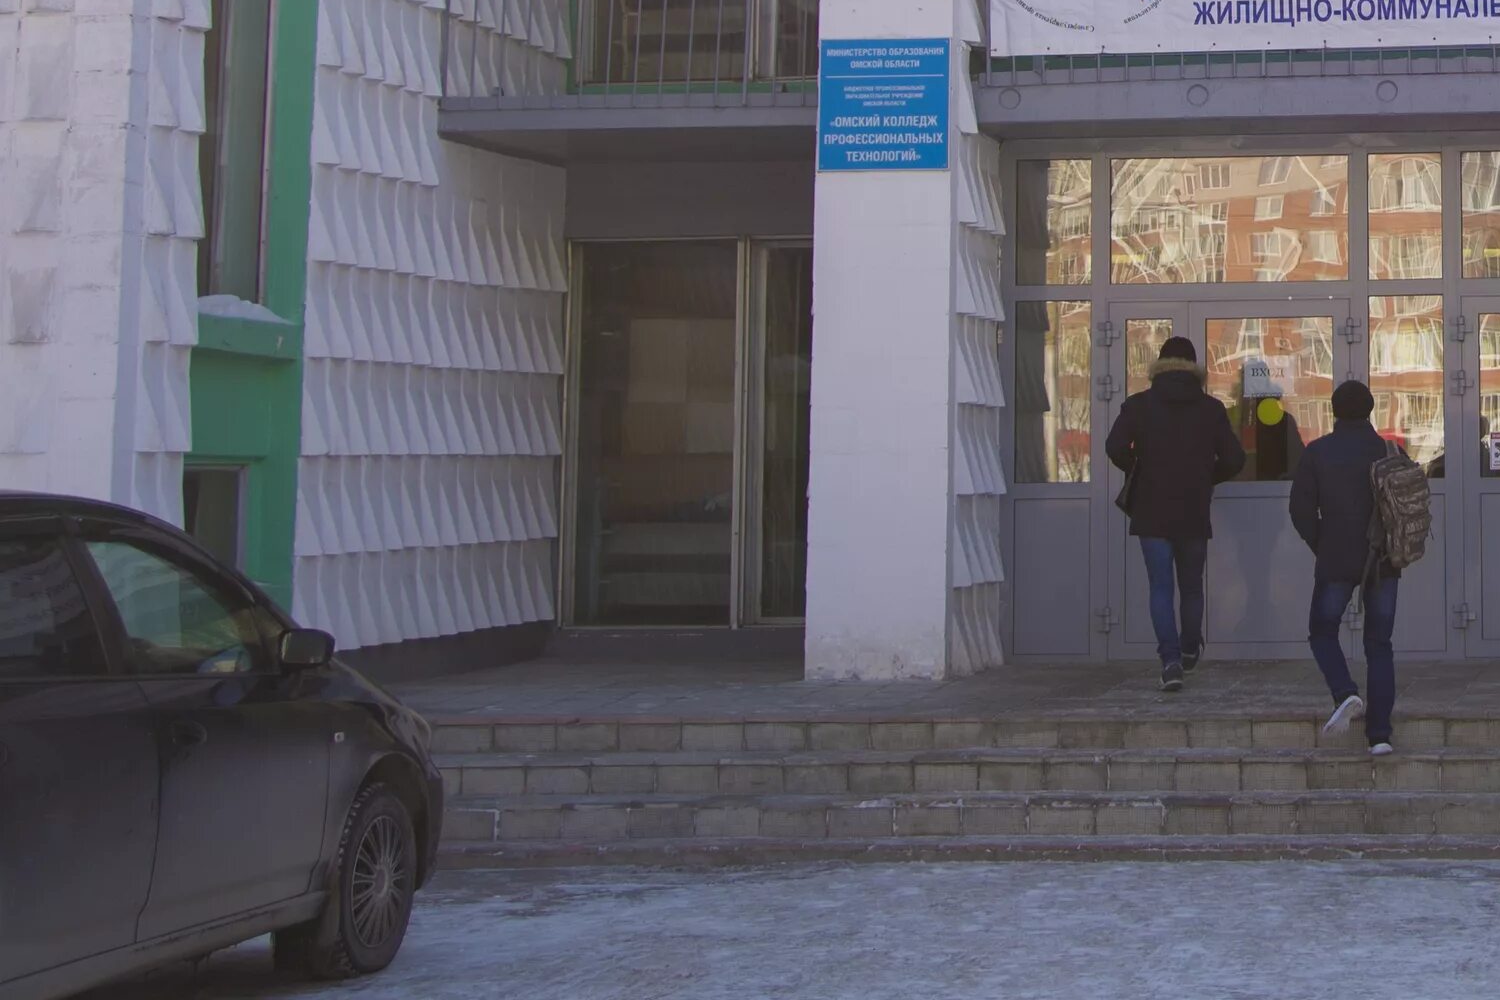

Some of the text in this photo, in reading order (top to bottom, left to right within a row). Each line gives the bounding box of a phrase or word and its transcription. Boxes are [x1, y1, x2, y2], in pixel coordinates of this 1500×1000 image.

[826, 46, 945, 57] МИНИСТЕРСТВО ОБРАЗОВАНИЯ
[850, 58, 920, 69] ОМСКОЙ ОБЛАСТИ
[830, 114, 938, 129] «ОМСКИЙ КОЛЛЕДЖ
[823, 132, 944, 146] ПРОФЕССИОНАЛЬНЫХ
[846, 147, 922, 162] ТЕХНОЛОГИЙ»
[1251, 367, 1285, 378] ВХОД
